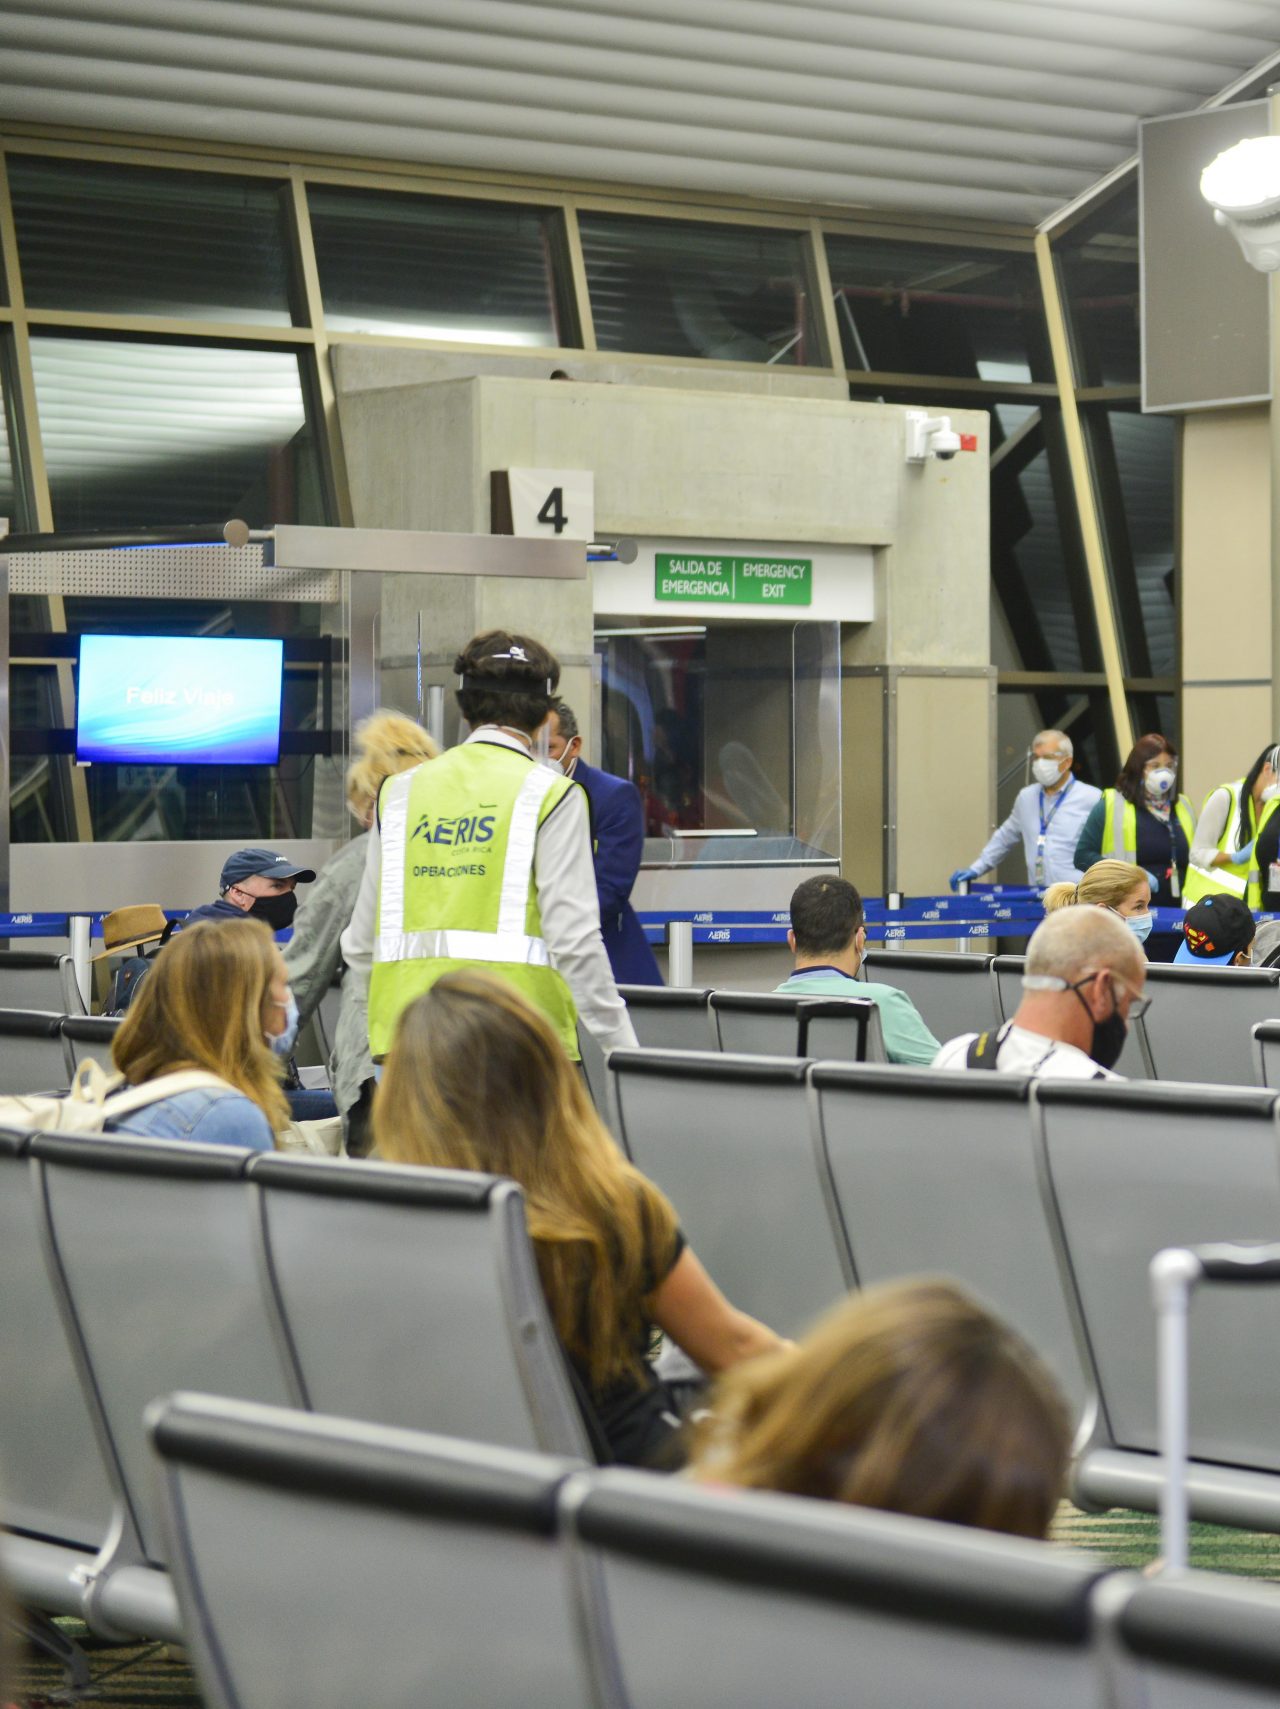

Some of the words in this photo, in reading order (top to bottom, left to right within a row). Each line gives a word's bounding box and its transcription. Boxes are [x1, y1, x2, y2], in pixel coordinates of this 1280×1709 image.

[537, 487, 568, 534] 4
[669, 560, 705, 575] SALIDA
[707, 561, 722, 576] DE
[743, 563, 806, 580] EMERGENCY
[662, 581, 730, 596] EMERGENCIA
[762, 584, 786, 598] EXIT
[126, 686, 177, 705] Feliz
[183, 686, 234, 710] Viaje
[410, 814, 496, 846] AERIS
[708, 929, 731, 940] AERIS
[885, 927, 906, 938] AERIS
[969, 923, 989, 934] AERIS
